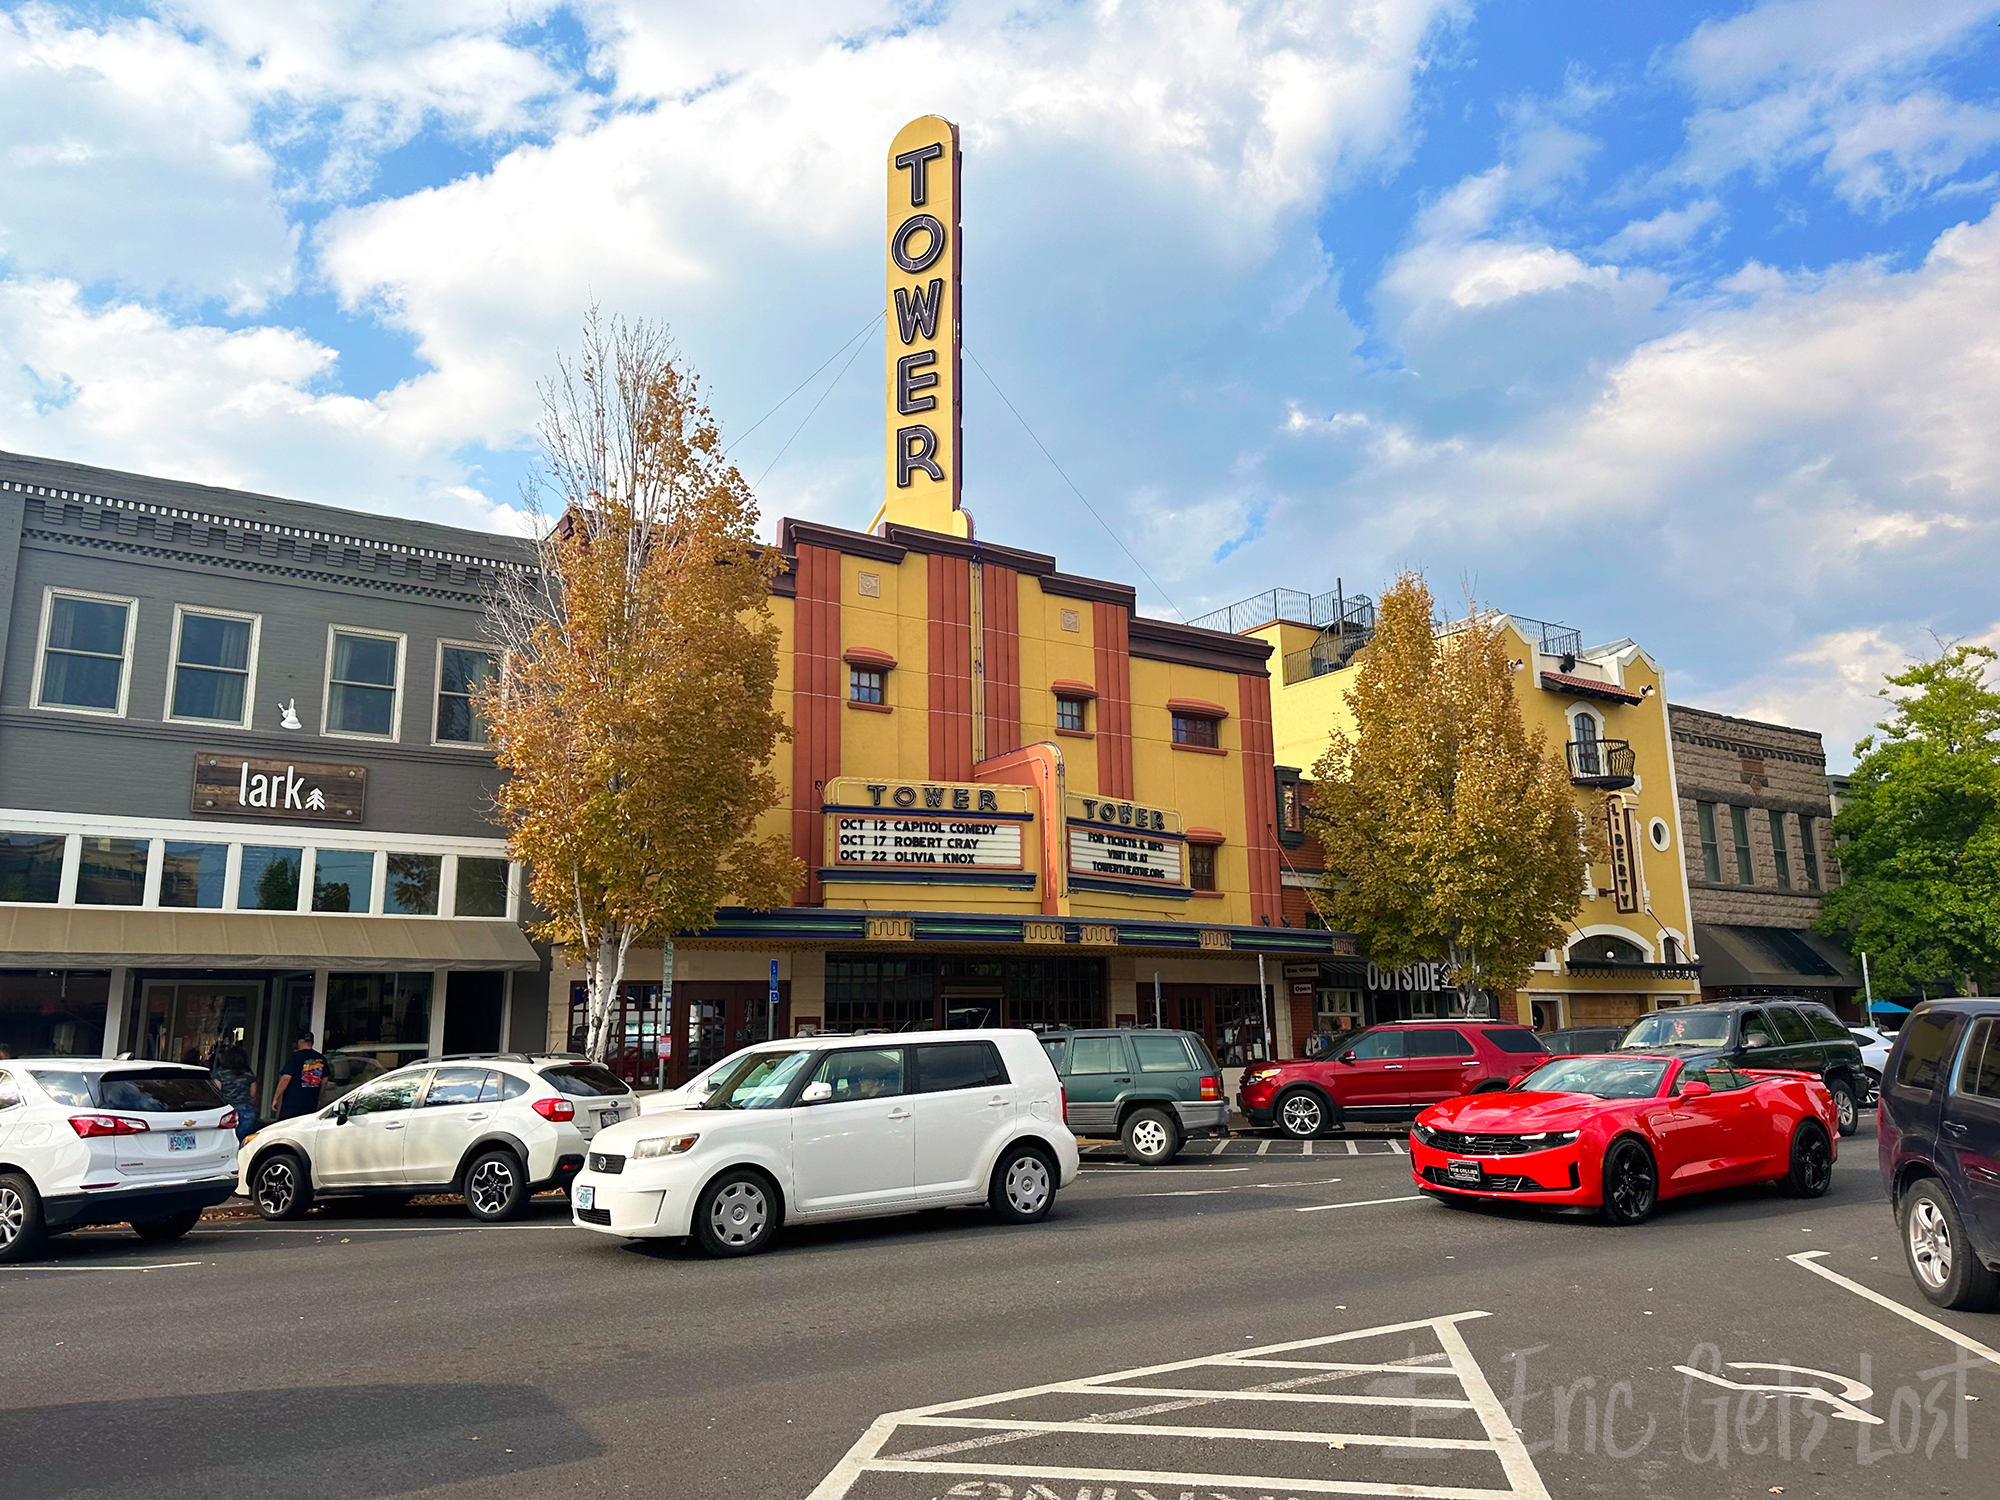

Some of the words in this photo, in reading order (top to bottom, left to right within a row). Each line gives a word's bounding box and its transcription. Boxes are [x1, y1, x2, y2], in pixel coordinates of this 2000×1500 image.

[891, 141, 945, 489] TOWER
[239, 761, 305, 810] lark
[867, 784, 998, 811] TOWER
[1083, 799, 1165, 831] TOWER
[840, 819, 865, 831] OCT
[874, 820, 887, 831] 12
[894, 820, 945, 833] CAPITOL
[950, 822, 998, 835] COMEDY
[840, 835, 865, 846] OCT
[874, 835, 887, 847] 17
[894, 836, 943, 848] ROBERT
[947, 838, 979, 850] CRAY
[1088, 832, 1105, 844] FOR
[1107, 835, 1137, 848] TICKETS
[840, 850, 865, 862] OCT
[872, 850, 887, 862] 22
[894, 851, 936, 863] OLIVIA
[943, 853, 975, 864] KNOX
[1107, 849, 1127, 861] VISIT
[1128, 852, 1138, 862] US
[1139, 854, 1149, 863] AT
[1611, 803, 1629, 907] LIBERTY
